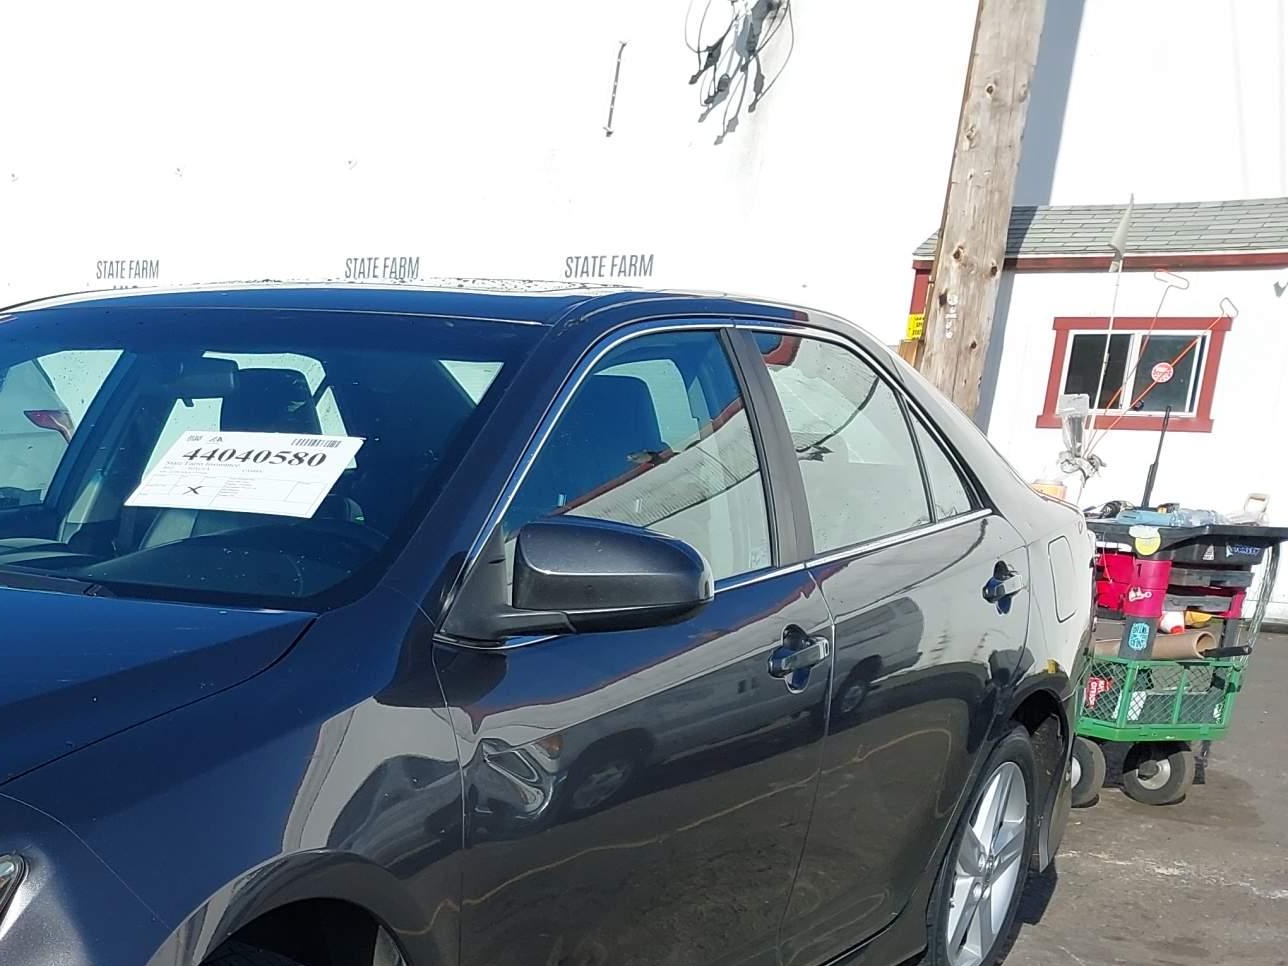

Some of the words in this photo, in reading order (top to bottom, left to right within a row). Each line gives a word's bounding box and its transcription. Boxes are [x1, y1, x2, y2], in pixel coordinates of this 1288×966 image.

[96, 260, 125, 279] STATE
[129, 259, 160, 279] FARM
[345, 257, 379, 280] STATE
[382, 256, 420, 280] FARM
[564, 256, 607, 278] STATE
[611, 254, 654, 277] FARM
[182, 447, 327, 467] 44040580
